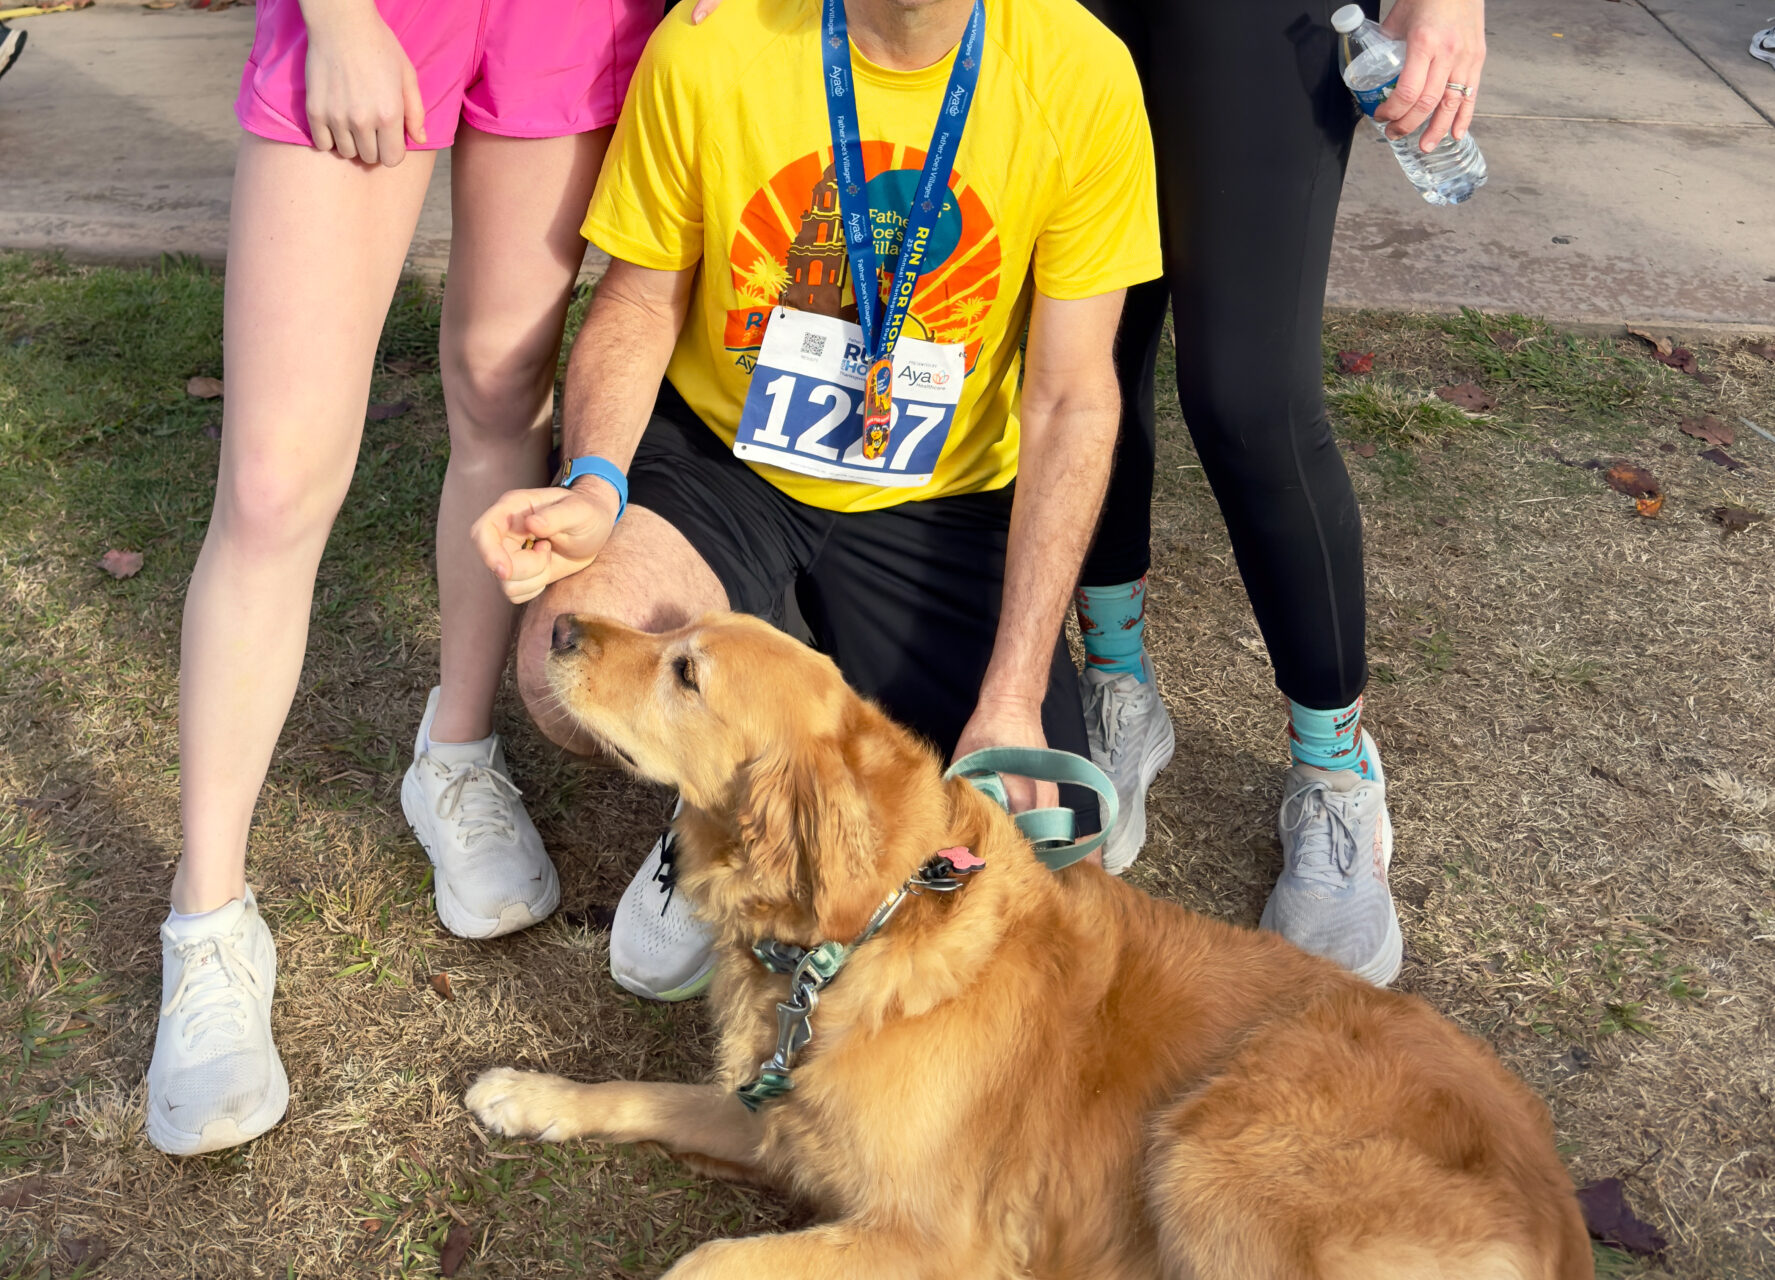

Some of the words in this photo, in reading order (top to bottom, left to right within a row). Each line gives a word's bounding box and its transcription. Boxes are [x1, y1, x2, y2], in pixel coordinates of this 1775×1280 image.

[829, 65, 842, 86] Aya
[951, 84, 966, 107] Aya
[837, 115, 845, 138] Father
[840, 138, 848, 156] Joe's
[939, 132, 949, 152] Father
[842, 155, 851, 184] Villages
[932, 152, 942, 172] Joe's
[924, 172, 937, 199] Villages
[848, 212, 860, 233] Aya
[869, 208, 910, 228] Fathe
[871, 225, 904, 242] oe's
[873, 241, 899, 256] illa
[908, 226, 930, 265] RUN
[897, 272, 916, 307] FOR
[886, 314, 903, 353] HOP
[735, 354, 758, 375] Ay
[845, 360, 868, 376] HO
[898, 365, 932, 386] Aya
